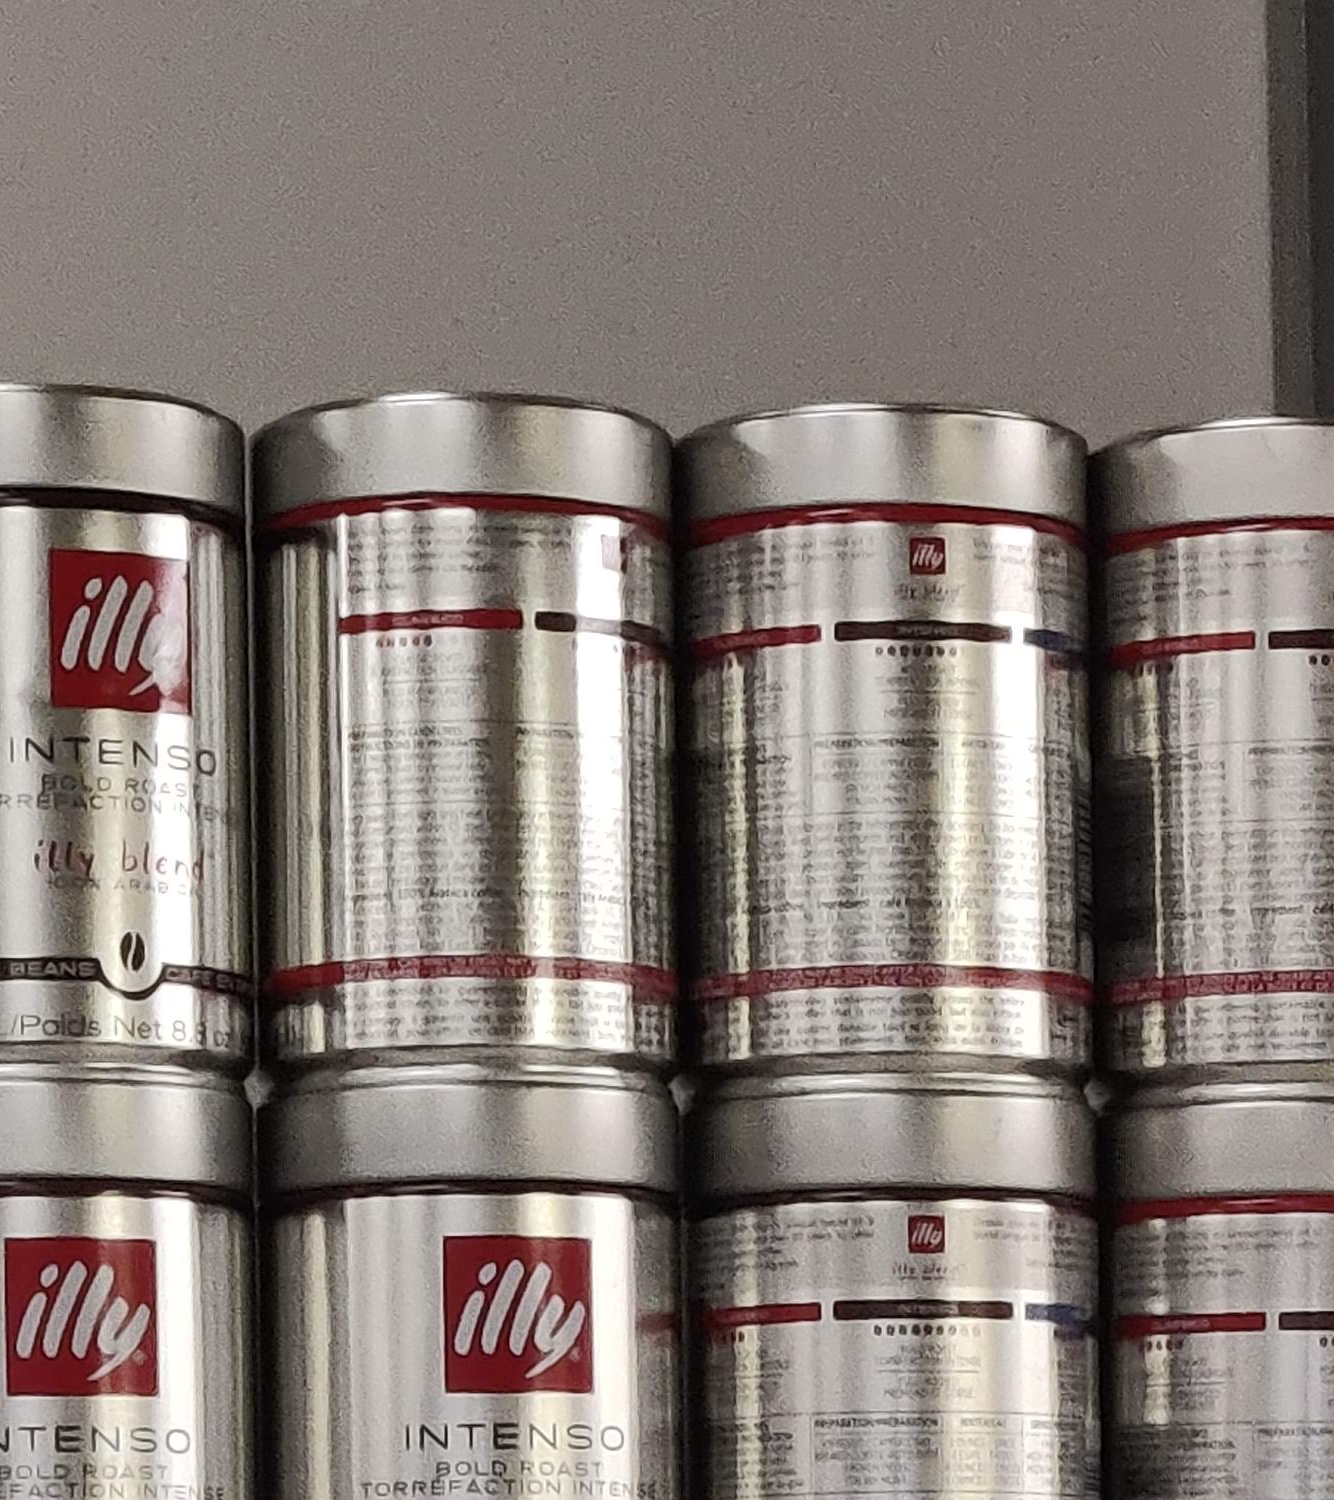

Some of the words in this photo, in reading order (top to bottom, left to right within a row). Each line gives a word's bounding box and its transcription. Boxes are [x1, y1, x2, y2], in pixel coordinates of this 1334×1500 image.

[10, 736, 216, 776] INTENSO
[34, 839, 94, 875] illy
[9, 962, 96, 977] BEANS
[114, 1016, 161, 1038] Net
[16, 1260, 150, 1381] illy
[454, 1259, 585, 1379] illy
[405, 1423, 625, 1451] INTENSO
[85, 1465, 168, 1480] ROAST
[436, 1461, 507, 1476] BOLD
[521, 1461, 602, 1476] ROAST
